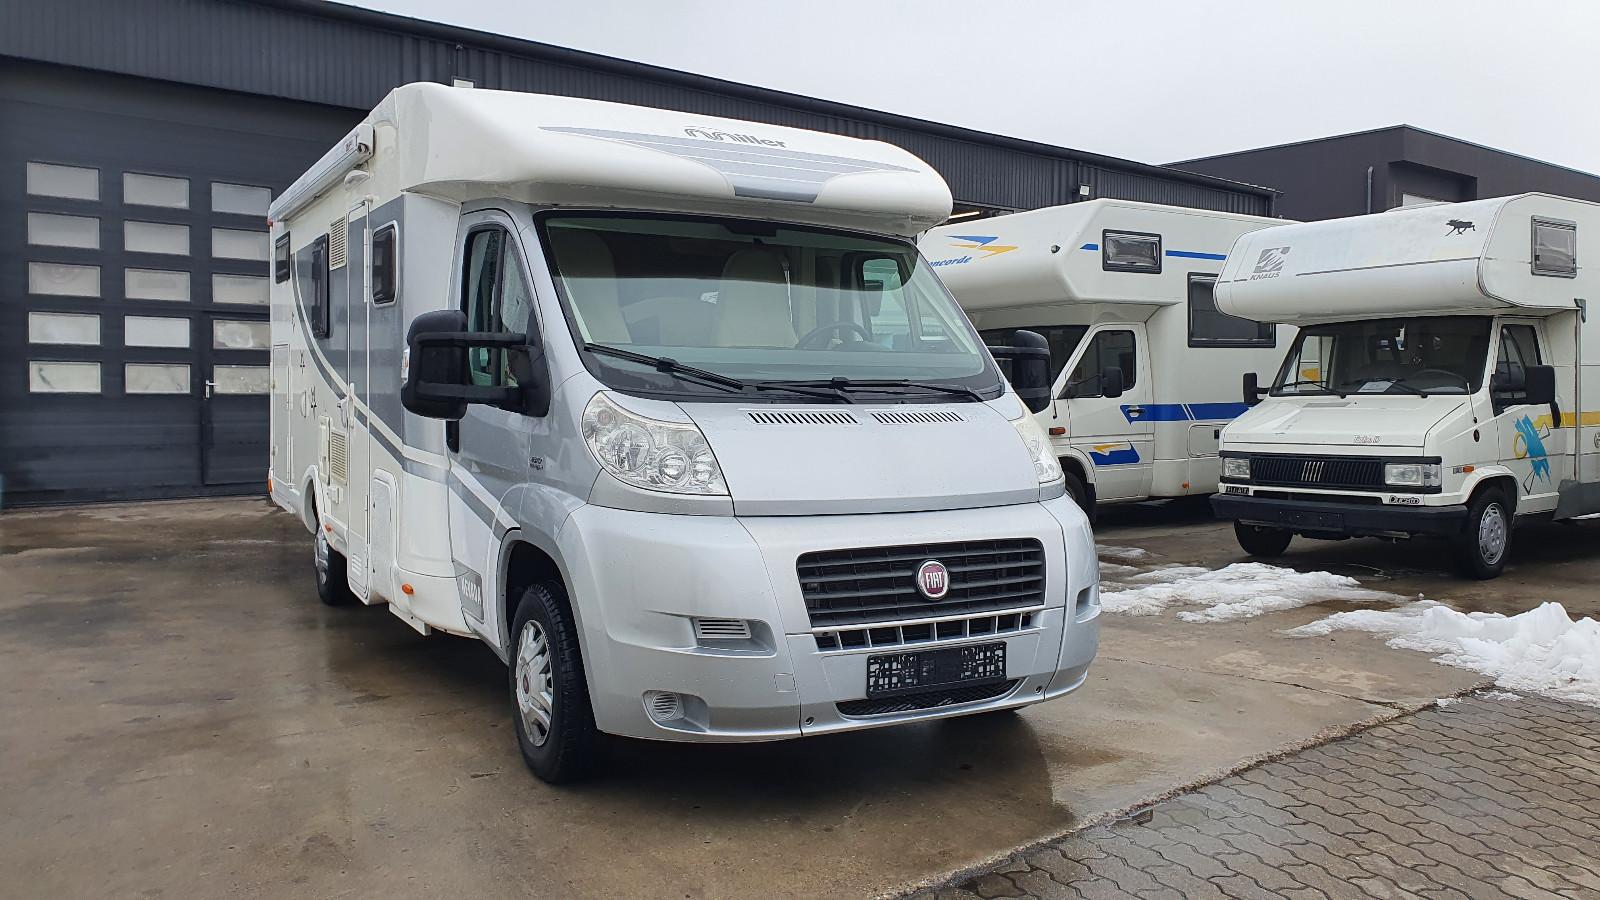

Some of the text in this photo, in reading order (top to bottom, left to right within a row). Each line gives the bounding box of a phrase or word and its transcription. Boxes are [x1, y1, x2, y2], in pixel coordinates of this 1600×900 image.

[928, 255, 972, 267] oncorde
[1250, 271, 1281, 281] KNAUS
[925, 571, 943, 589] FIAT
